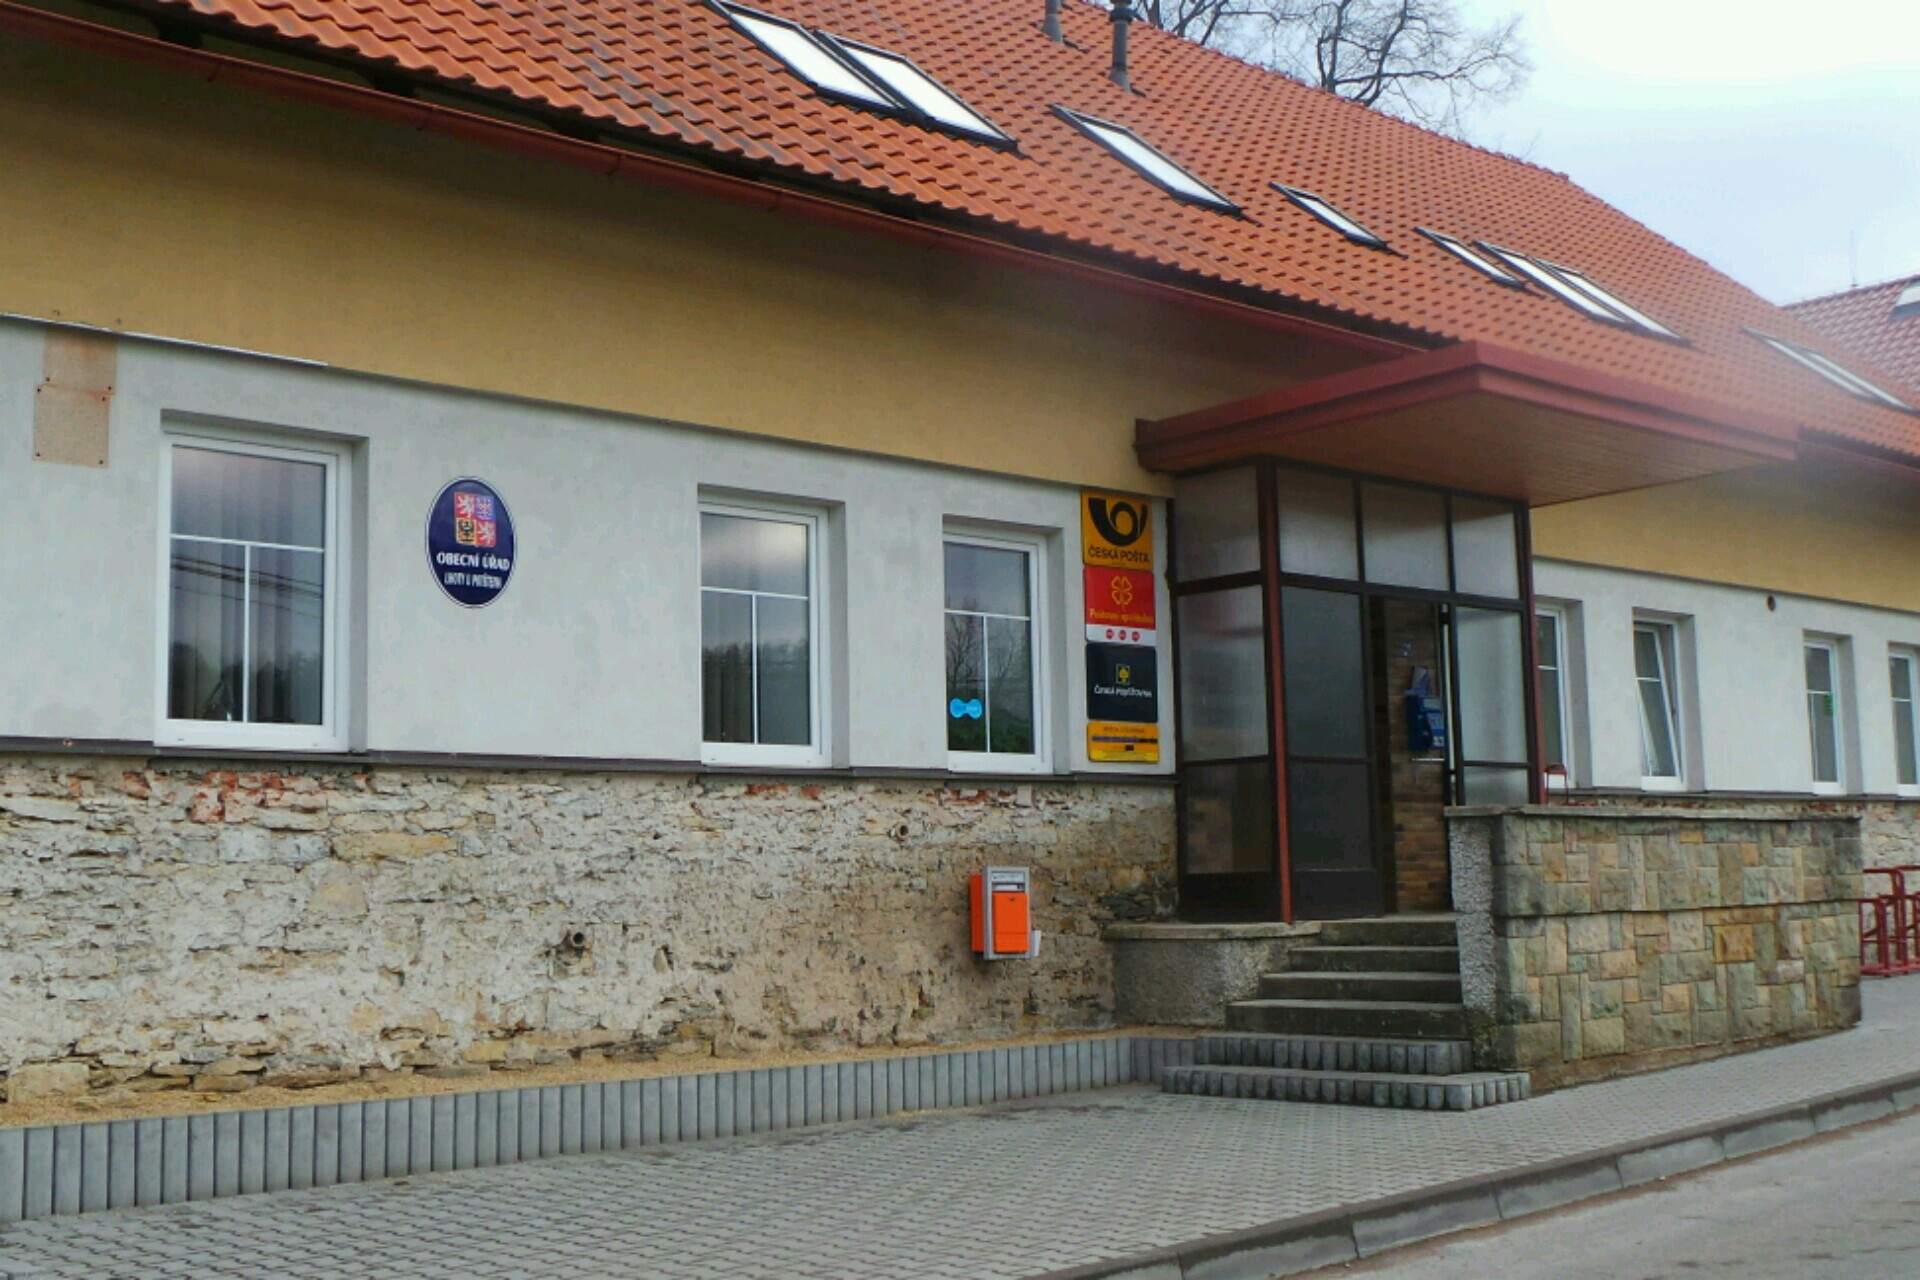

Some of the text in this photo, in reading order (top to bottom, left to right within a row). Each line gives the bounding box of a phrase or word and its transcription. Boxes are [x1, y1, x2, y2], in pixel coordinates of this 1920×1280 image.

[436, 551, 510, 571] OBECNÍ ÚŘAD
[1088, 544, 1151, 563] ČESKÁ POŠTA
